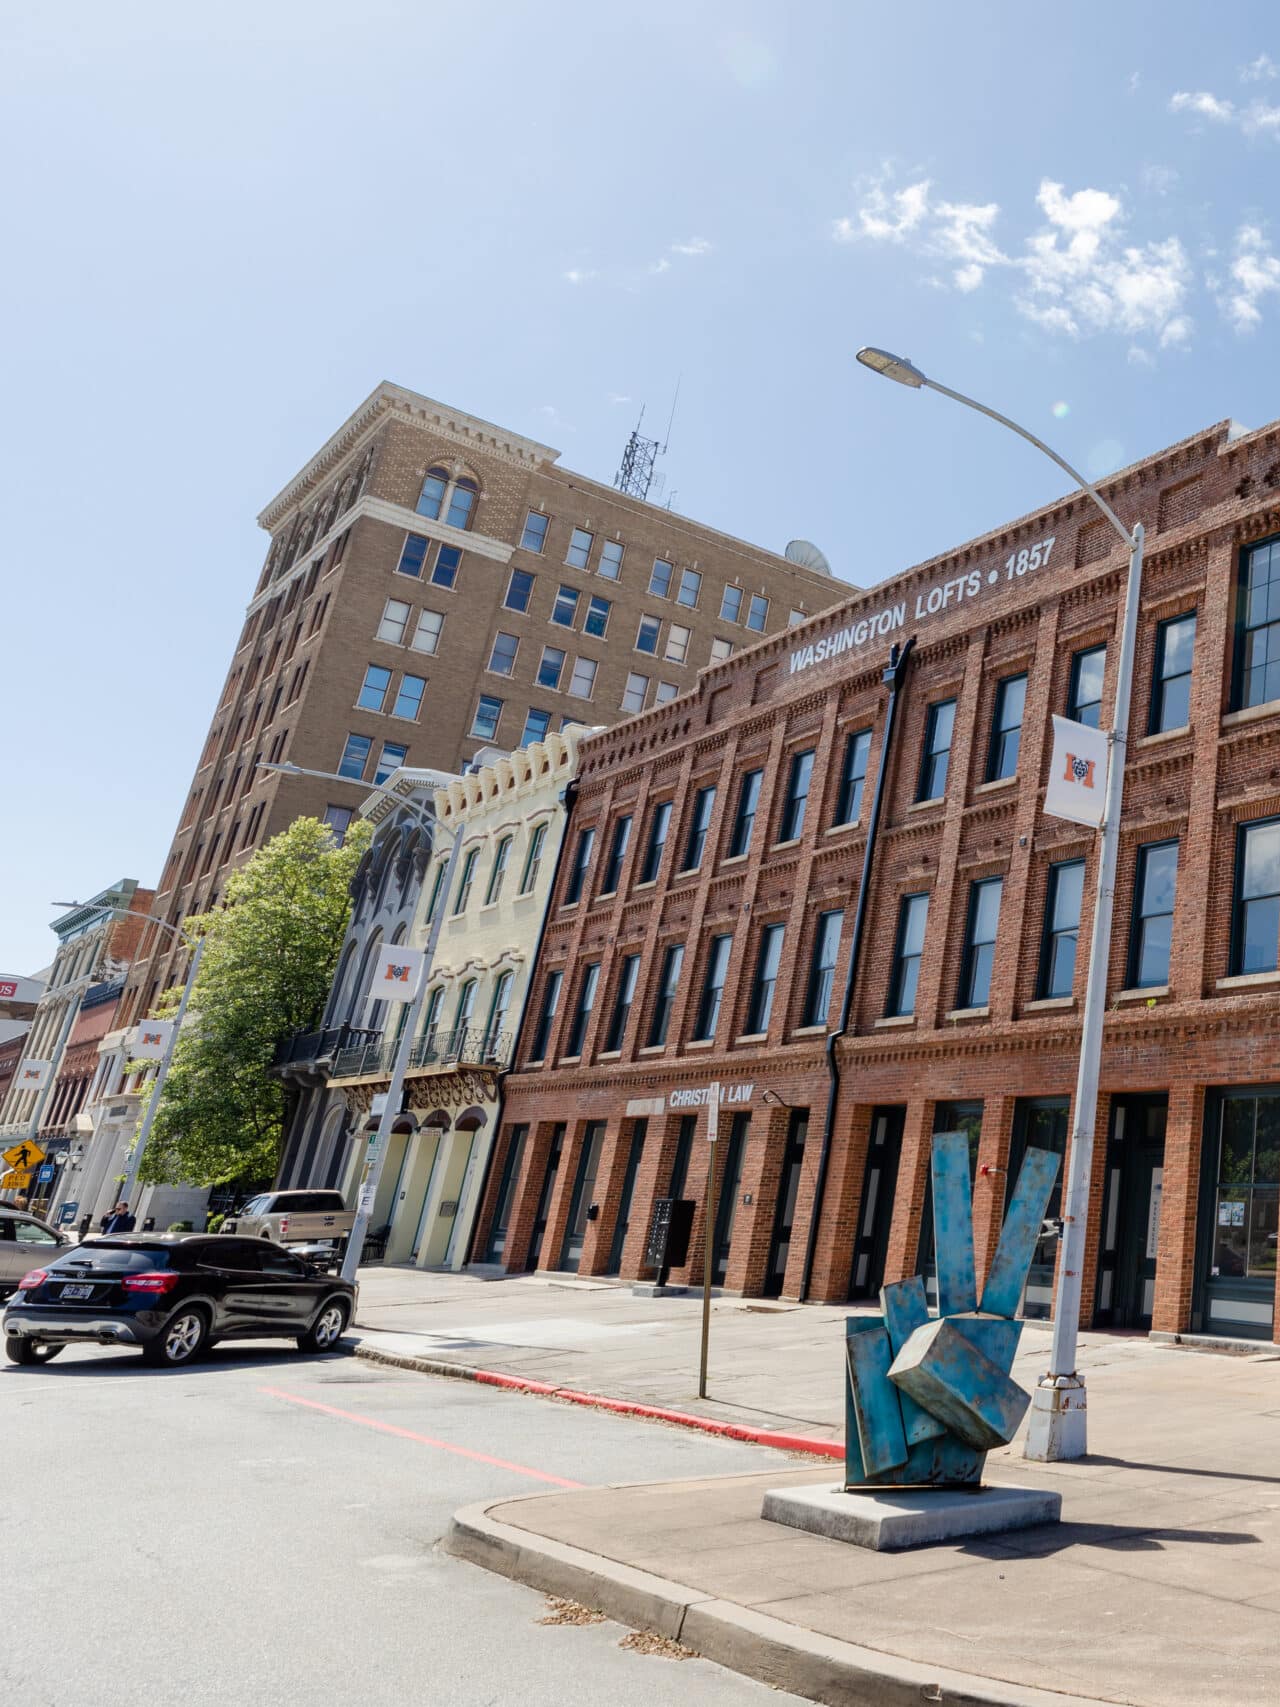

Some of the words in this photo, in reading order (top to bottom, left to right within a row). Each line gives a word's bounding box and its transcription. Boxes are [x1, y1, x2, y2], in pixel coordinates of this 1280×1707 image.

[790, 602, 906, 674] WASHINGTON
[914, 569, 981, 620] LOFTS
[1005, 536, 1056, 580] 1857
[728, 1084, 754, 1103] LAW
